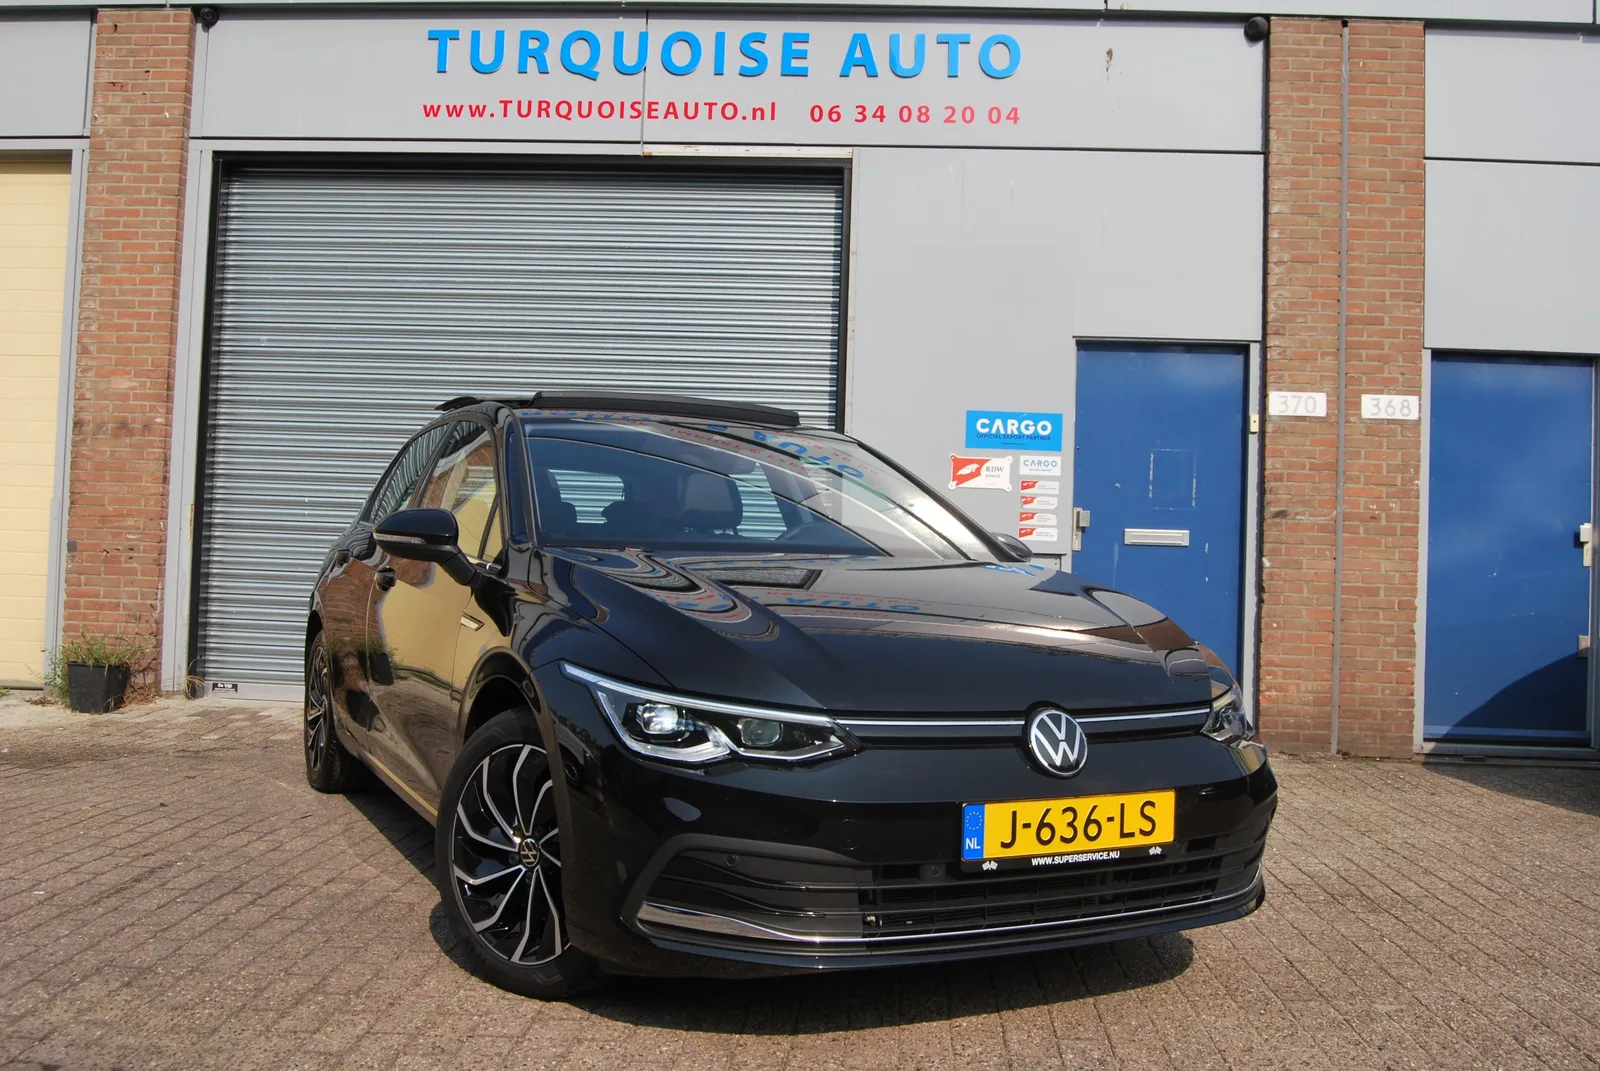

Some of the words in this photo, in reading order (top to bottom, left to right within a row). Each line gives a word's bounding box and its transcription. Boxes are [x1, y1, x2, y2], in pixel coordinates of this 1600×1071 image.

[427, 29, 811, 80] TURQUOISE
[840, 32, 1022, 78] AUTO
[423, 99, 776, 121] www.TURQUOISEAUTO.nl
[809, 104, 842, 123] 06
[854, 104, 886, 123] 34
[898, 104, 930, 124] 08
[944, 105, 976, 124] 20
[988, 106, 1020, 125] 04
[1278, 395, 1317, 414] 370
[1370, 398, 1412, 417] 368
[976, 418, 1052, 436] CARGO
[1023, 459, 1058, 467] CARGO
[1000, 800, 1156, 849] J-636-LS
[966, 837, 981, 850] NL
[1031, 850, 1121, 866] WWW.SUPERSERVICE.NU
